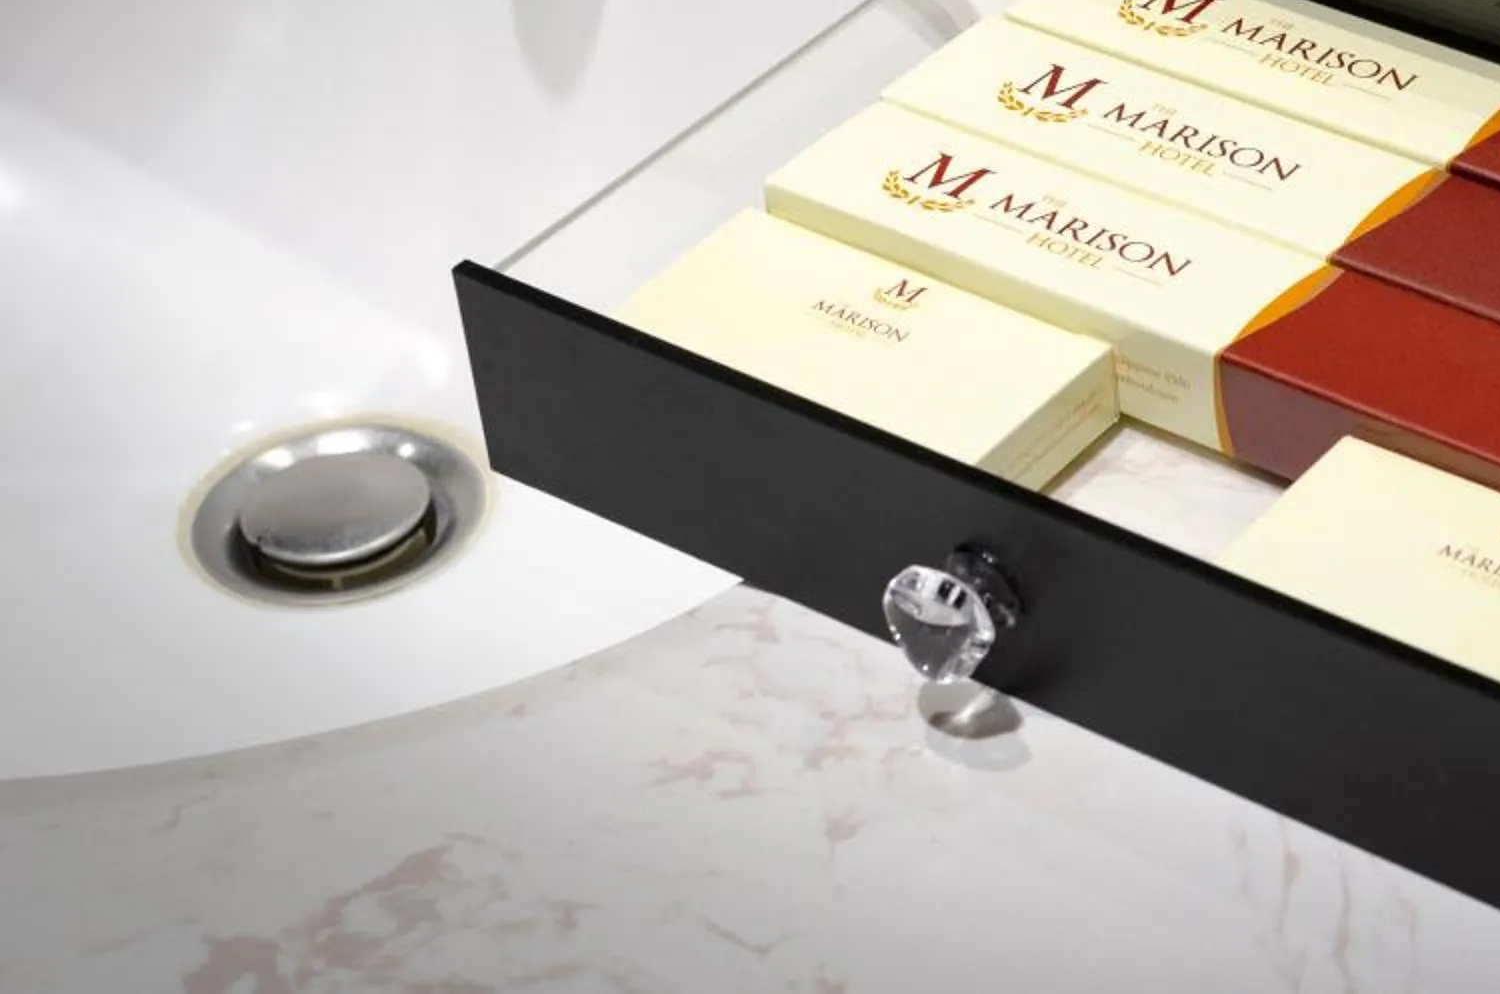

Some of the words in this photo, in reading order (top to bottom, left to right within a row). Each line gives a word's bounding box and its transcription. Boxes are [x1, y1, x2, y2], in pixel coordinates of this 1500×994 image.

[1221, 17, 1418, 91] MARISON
[1258, 52, 1337, 86] HOTEL
[1016, 63, 1109, 109] M
[1102, 102, 1302, 182] MARISON
[1138, 140, 1217, 177] HOTEL
[903, 152, 996, 199] M
[989, 193, 1193, 277] MARISON
[1026, 231, 1105, 270] HOTEL
[883, 278, 929, 304] M
[809, 299, 911, 343] MARISON
